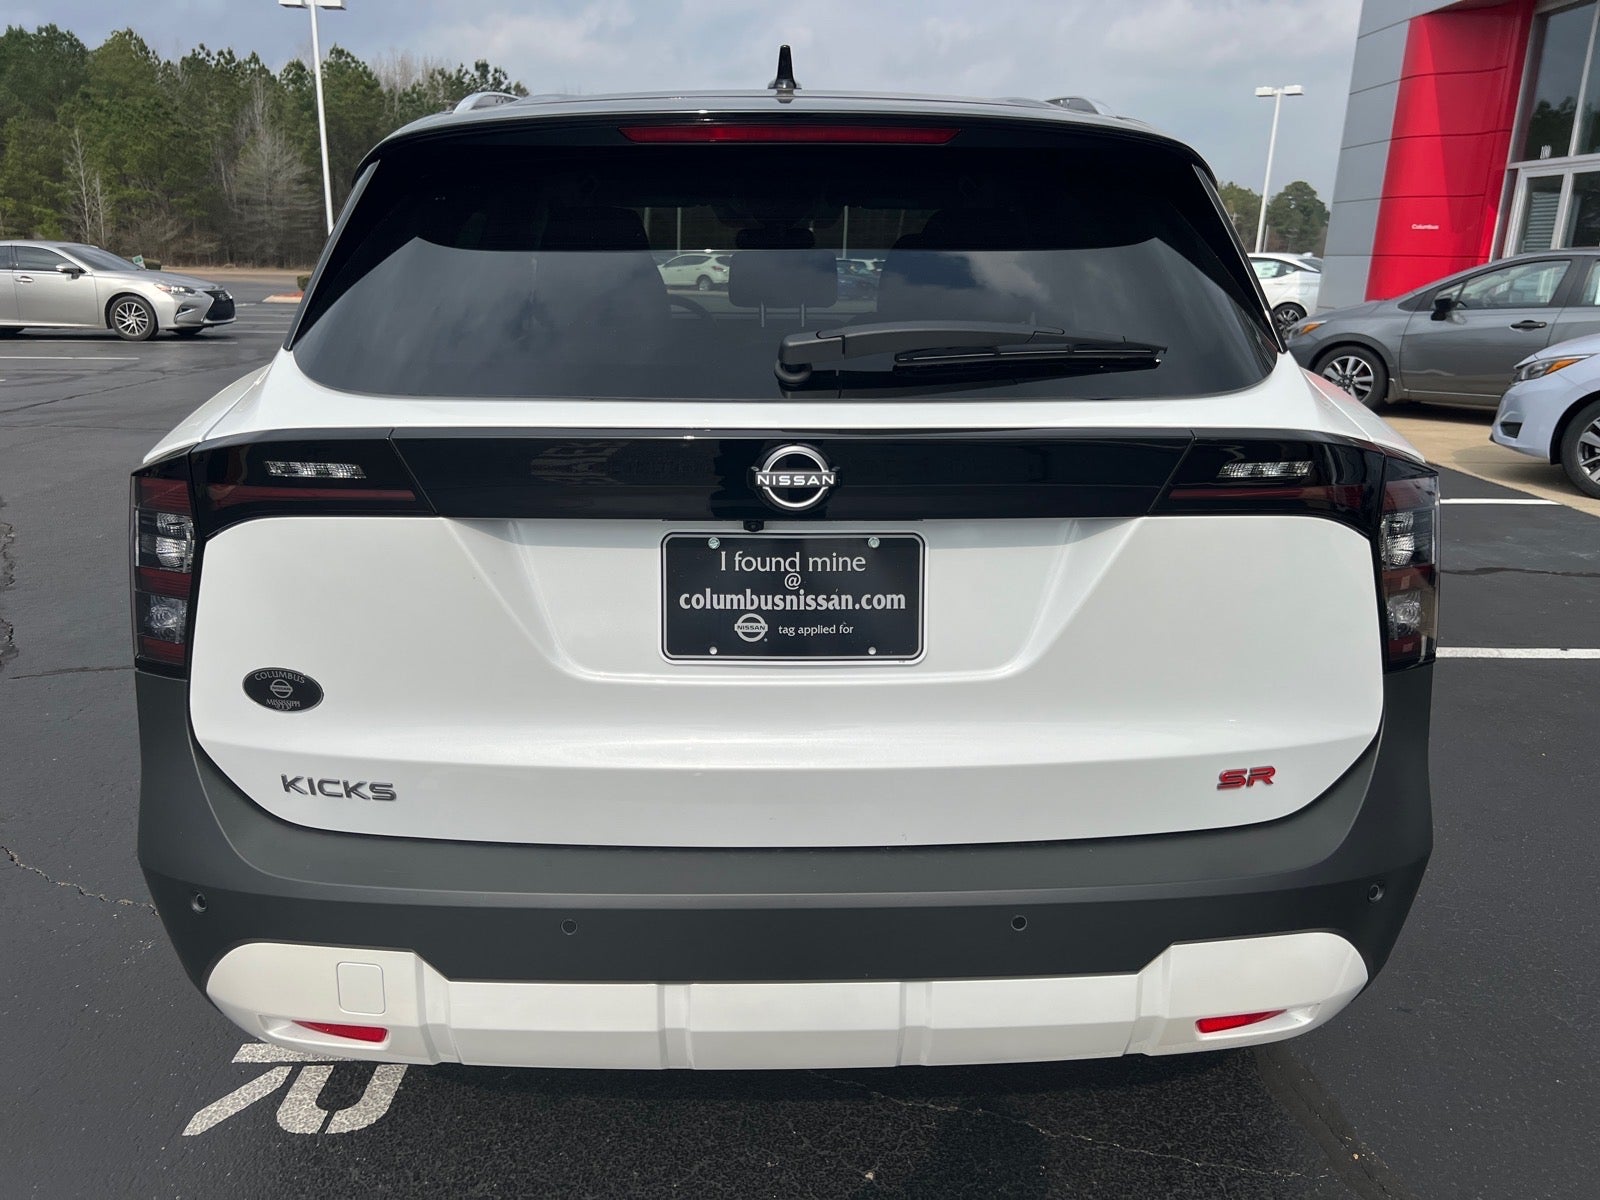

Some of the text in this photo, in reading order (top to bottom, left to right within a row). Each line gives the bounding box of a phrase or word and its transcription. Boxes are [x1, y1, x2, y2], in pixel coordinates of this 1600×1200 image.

[757, 474, 835, 486] NISSAN
[720, 551, 867, 572] I found mine
[784, 573, 801, 590] @
[679, 588, 906, 610] columbusnissan.com
[736, 624, 766, 632] NISSAN
[778, 624, 854, 636] tag applied for
[254, 670, 305, 684] COLUMBUS
[1216, 765, 1276, 791] SR
[280, 773, 397, 801] KICKS
